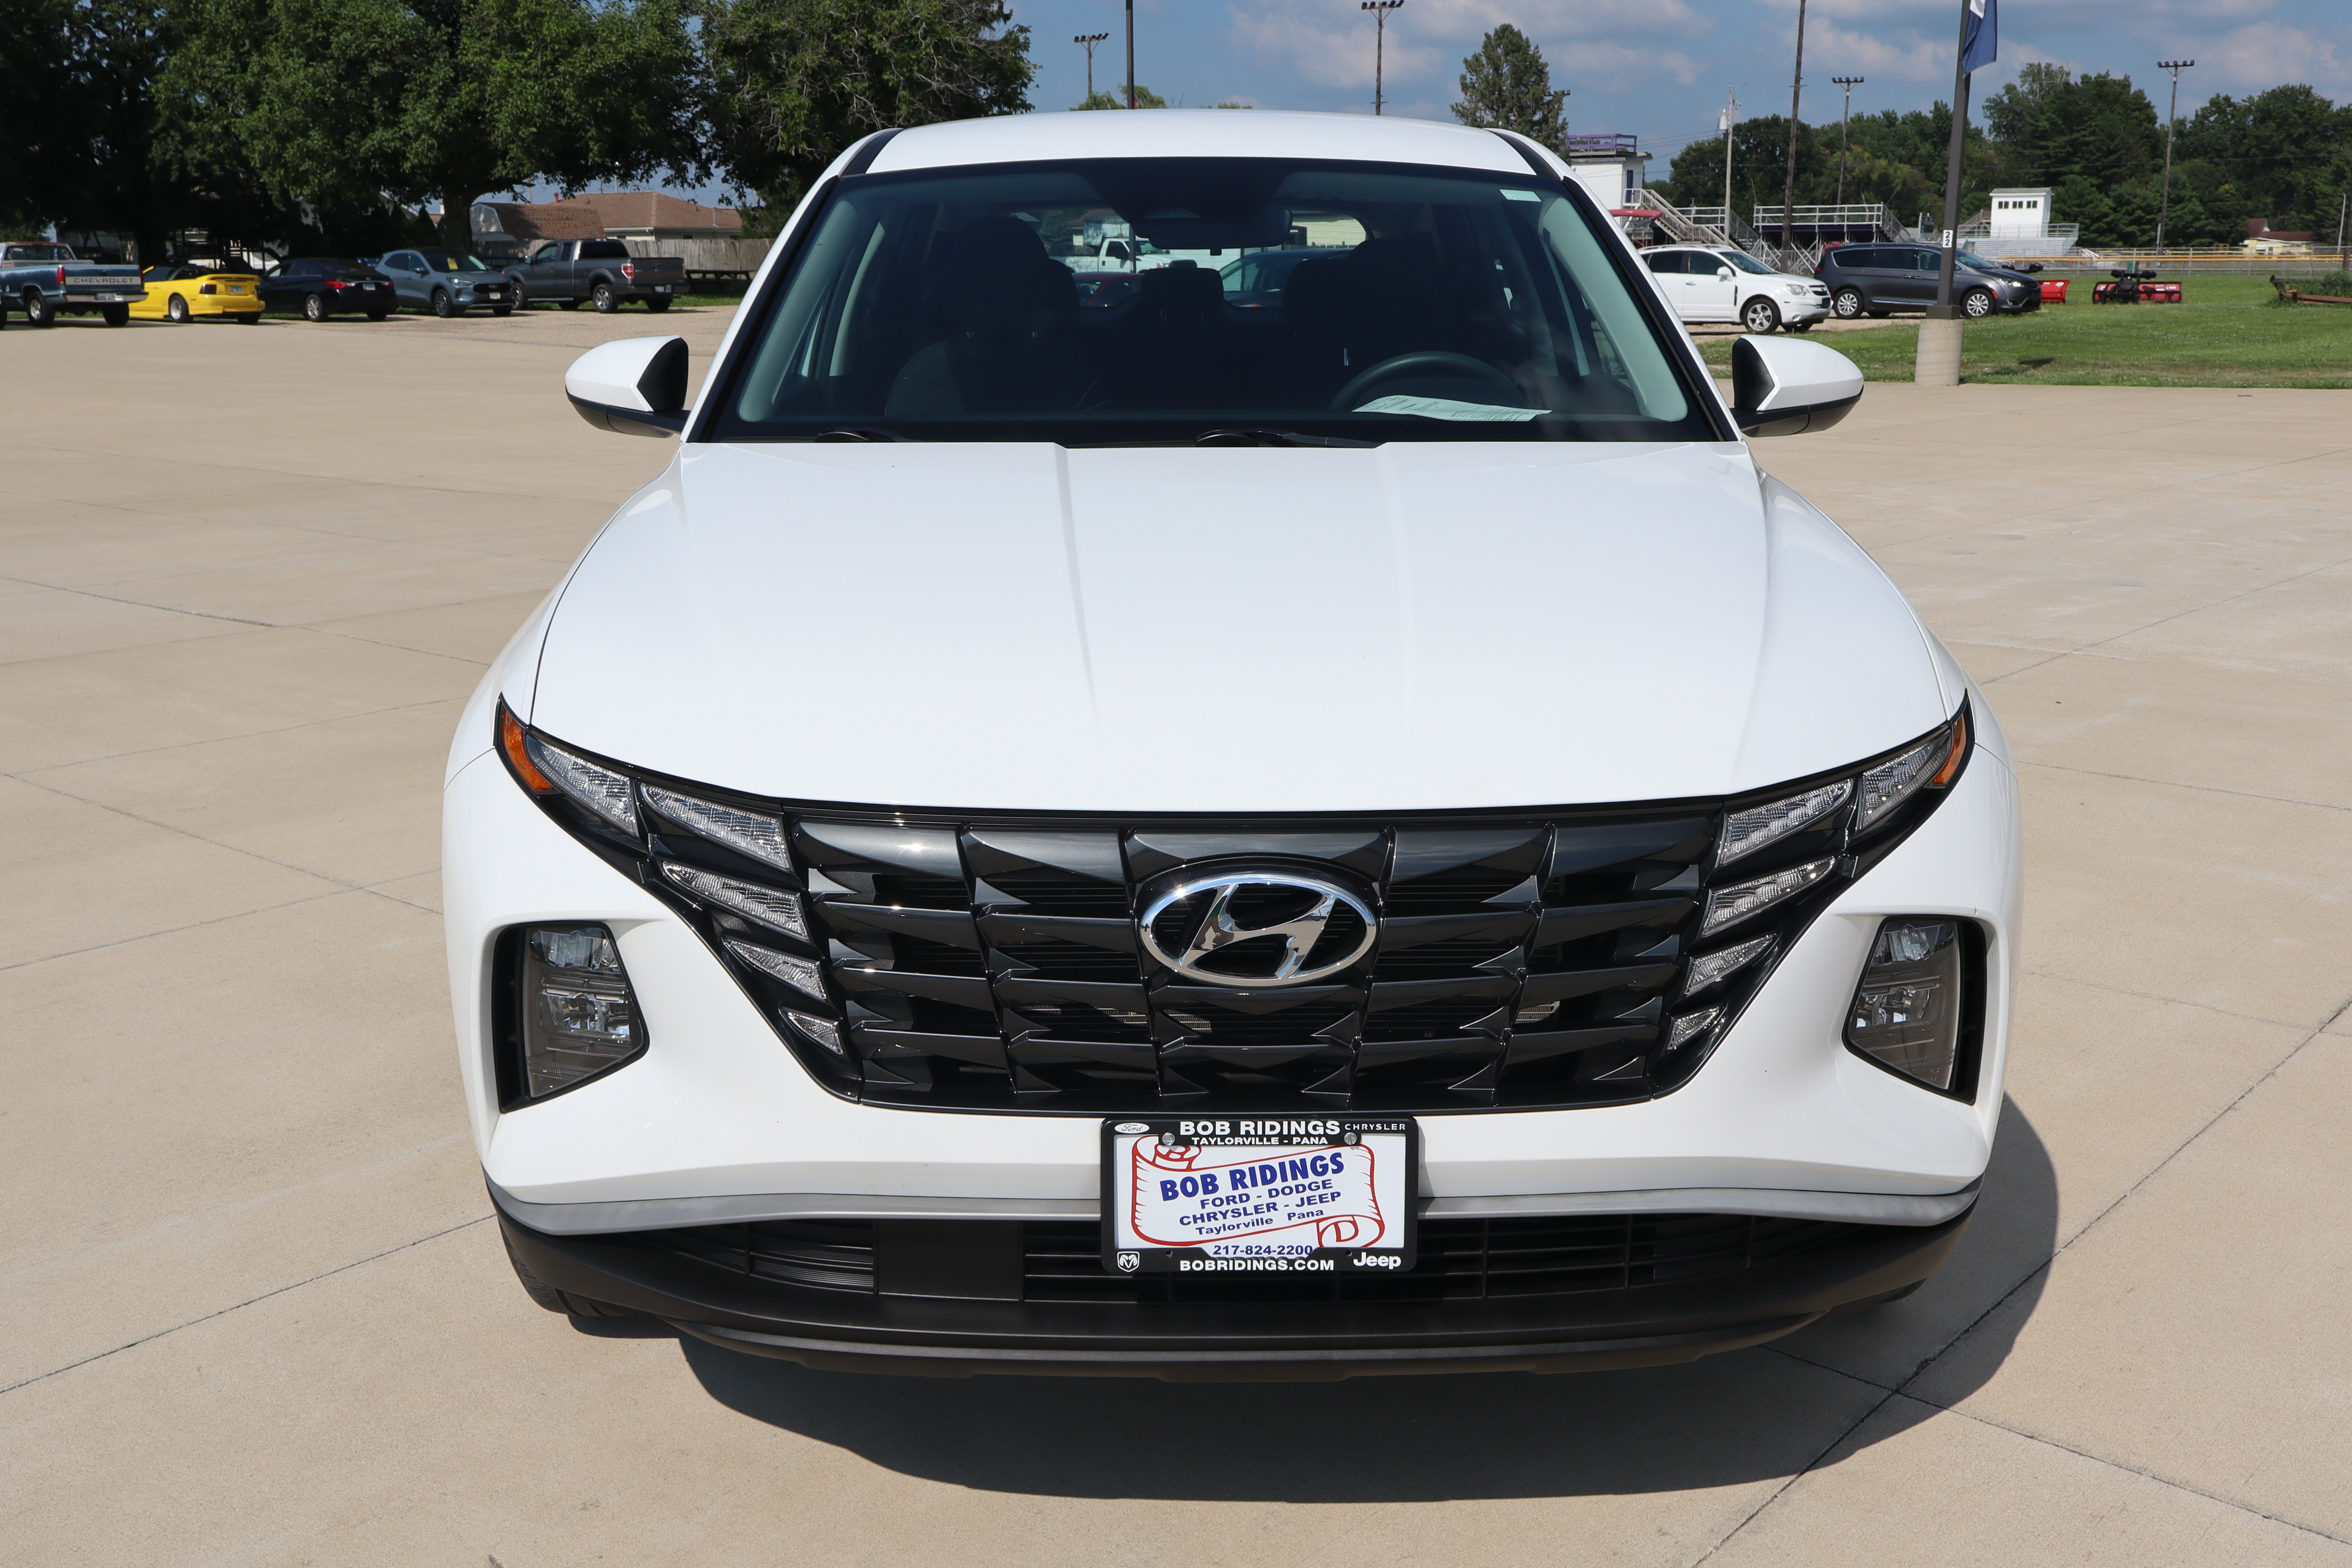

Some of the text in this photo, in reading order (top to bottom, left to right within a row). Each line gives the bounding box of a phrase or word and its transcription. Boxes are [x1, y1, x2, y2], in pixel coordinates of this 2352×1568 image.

[1121, 1123, 1143, 1132] Ford
[1180, 1120, 1341, 1136] BOB RIDINGS
[1191, 1137, 1279, 1145] TAYLORVILLE
[1292, 1136, 1328, 1145] PANA
[1160, 1152, 1344, 1202] BOB RIDINGS
[1200, 1192, 1251, 1209] FORD
[1267, 1178, 1333, 1198] DODGE
[1179, 1201, 1279, 1226] CHRYSLER
[1295, 1191, 1341, 1207] JEEP
[1195, 1209, 1324, 1235] Taylorville Pana
[1213, 1245, 1313, 1255] 217-824-2200
[1180, 1259, 1334, 1271] BOBRIDINGS.COM
[1353, 1252, 1401, 1270] Jeep
